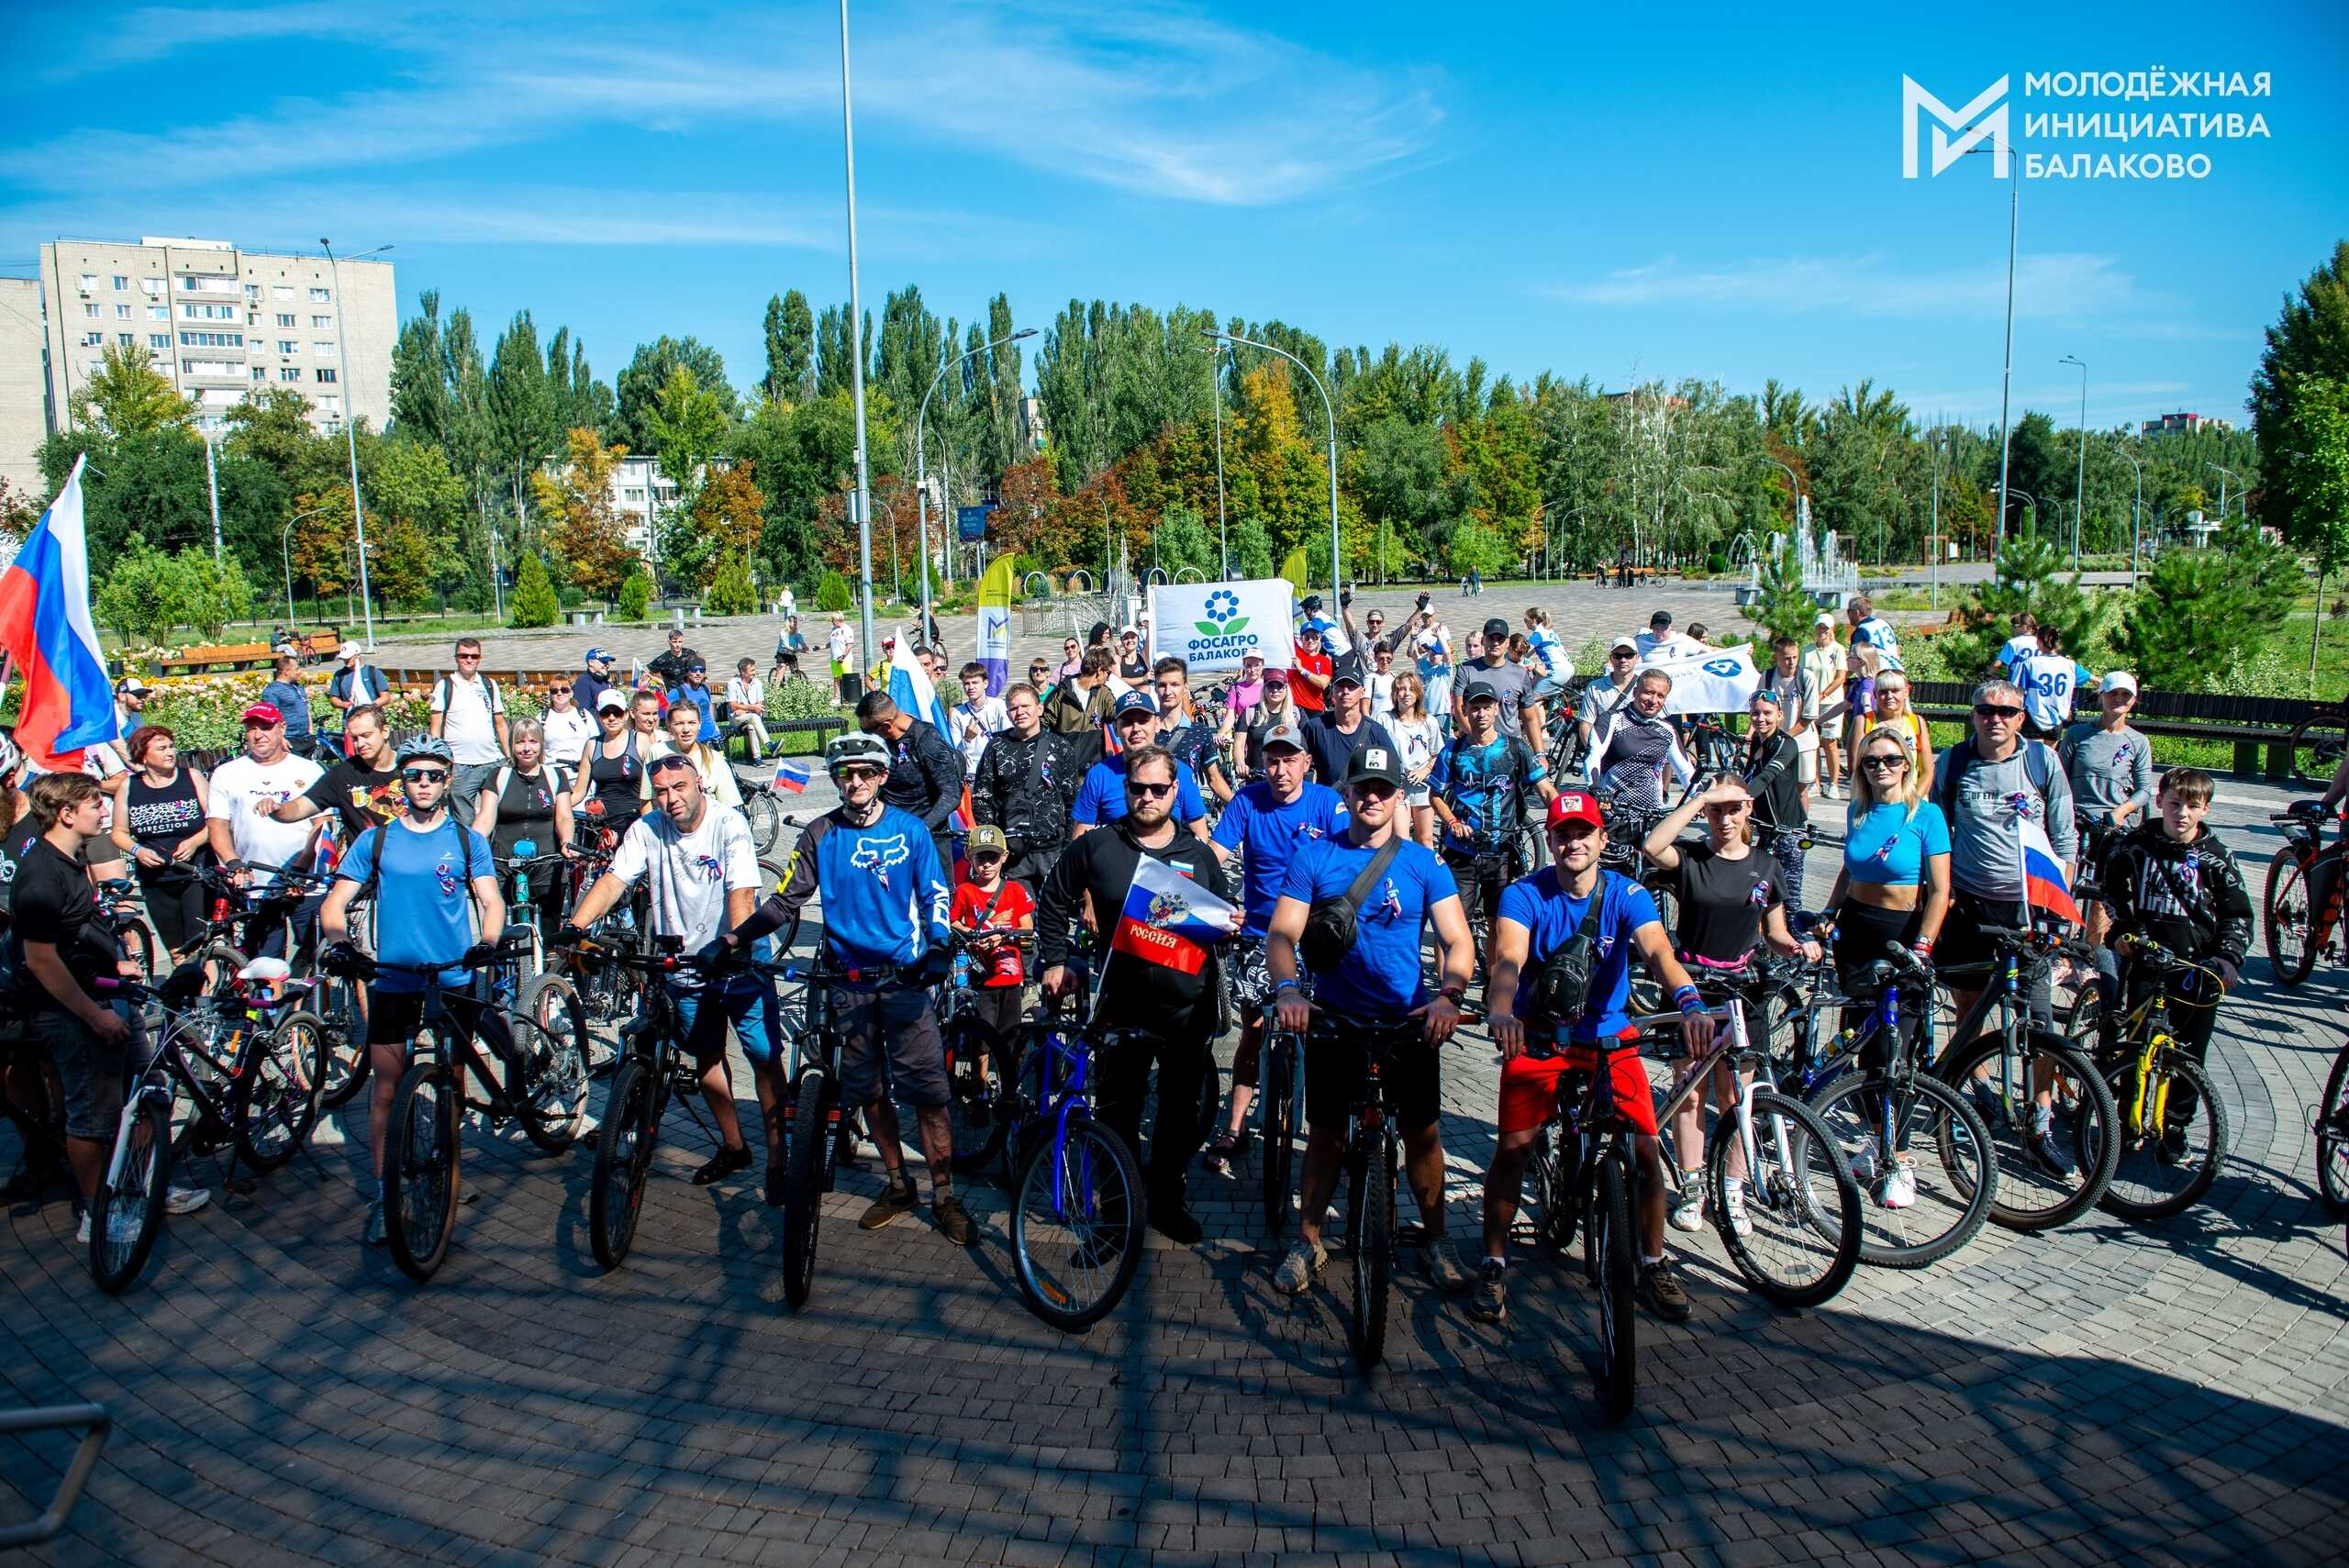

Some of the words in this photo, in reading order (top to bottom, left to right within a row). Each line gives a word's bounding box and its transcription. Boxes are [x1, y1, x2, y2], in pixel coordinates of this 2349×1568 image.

[1187, 634, 1258, 651] ФОСАГРО
[2038, 673, 2067, 697] 36
[138, 821, 189, 834] DIRECTION
[1130, 924, 1178, 949] РОССИЯ
